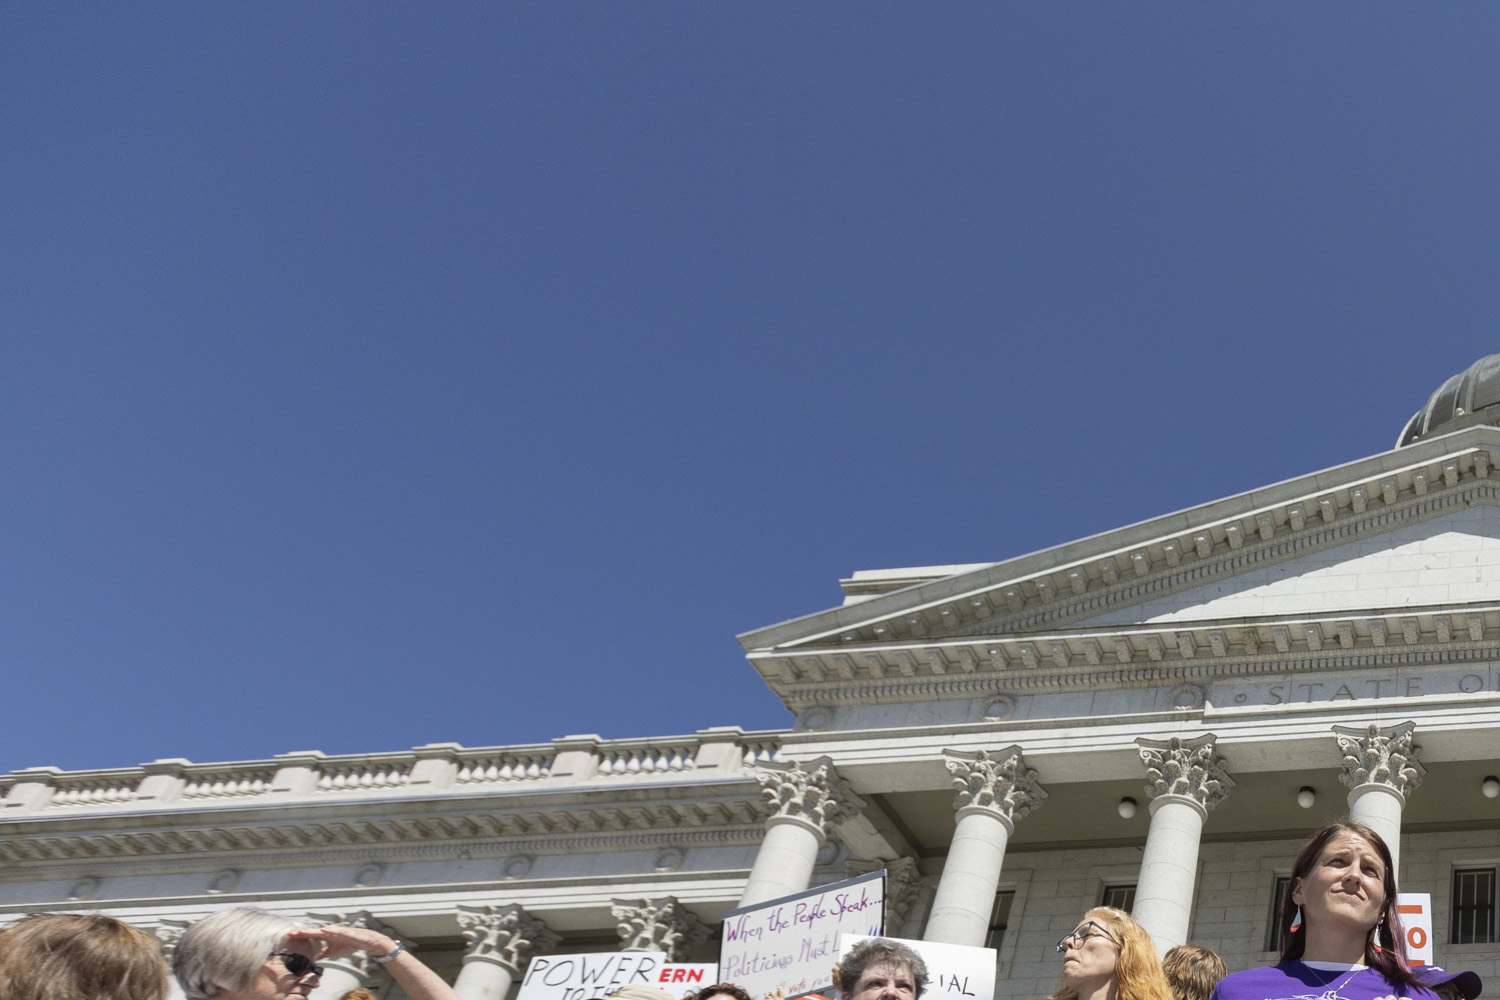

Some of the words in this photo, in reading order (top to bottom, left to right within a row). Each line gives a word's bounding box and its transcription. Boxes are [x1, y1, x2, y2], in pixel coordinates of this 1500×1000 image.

[1265, 676, 1425, 706] STATE
[727, 912, 763, 943] When
[767, 907, 790, 934] the
[1401, 926, 1428, 949] O
[524, 955, 656, 987] POWER
[658, 968, 704, 983] ERN
[927, 974, 976, 997] IAL
